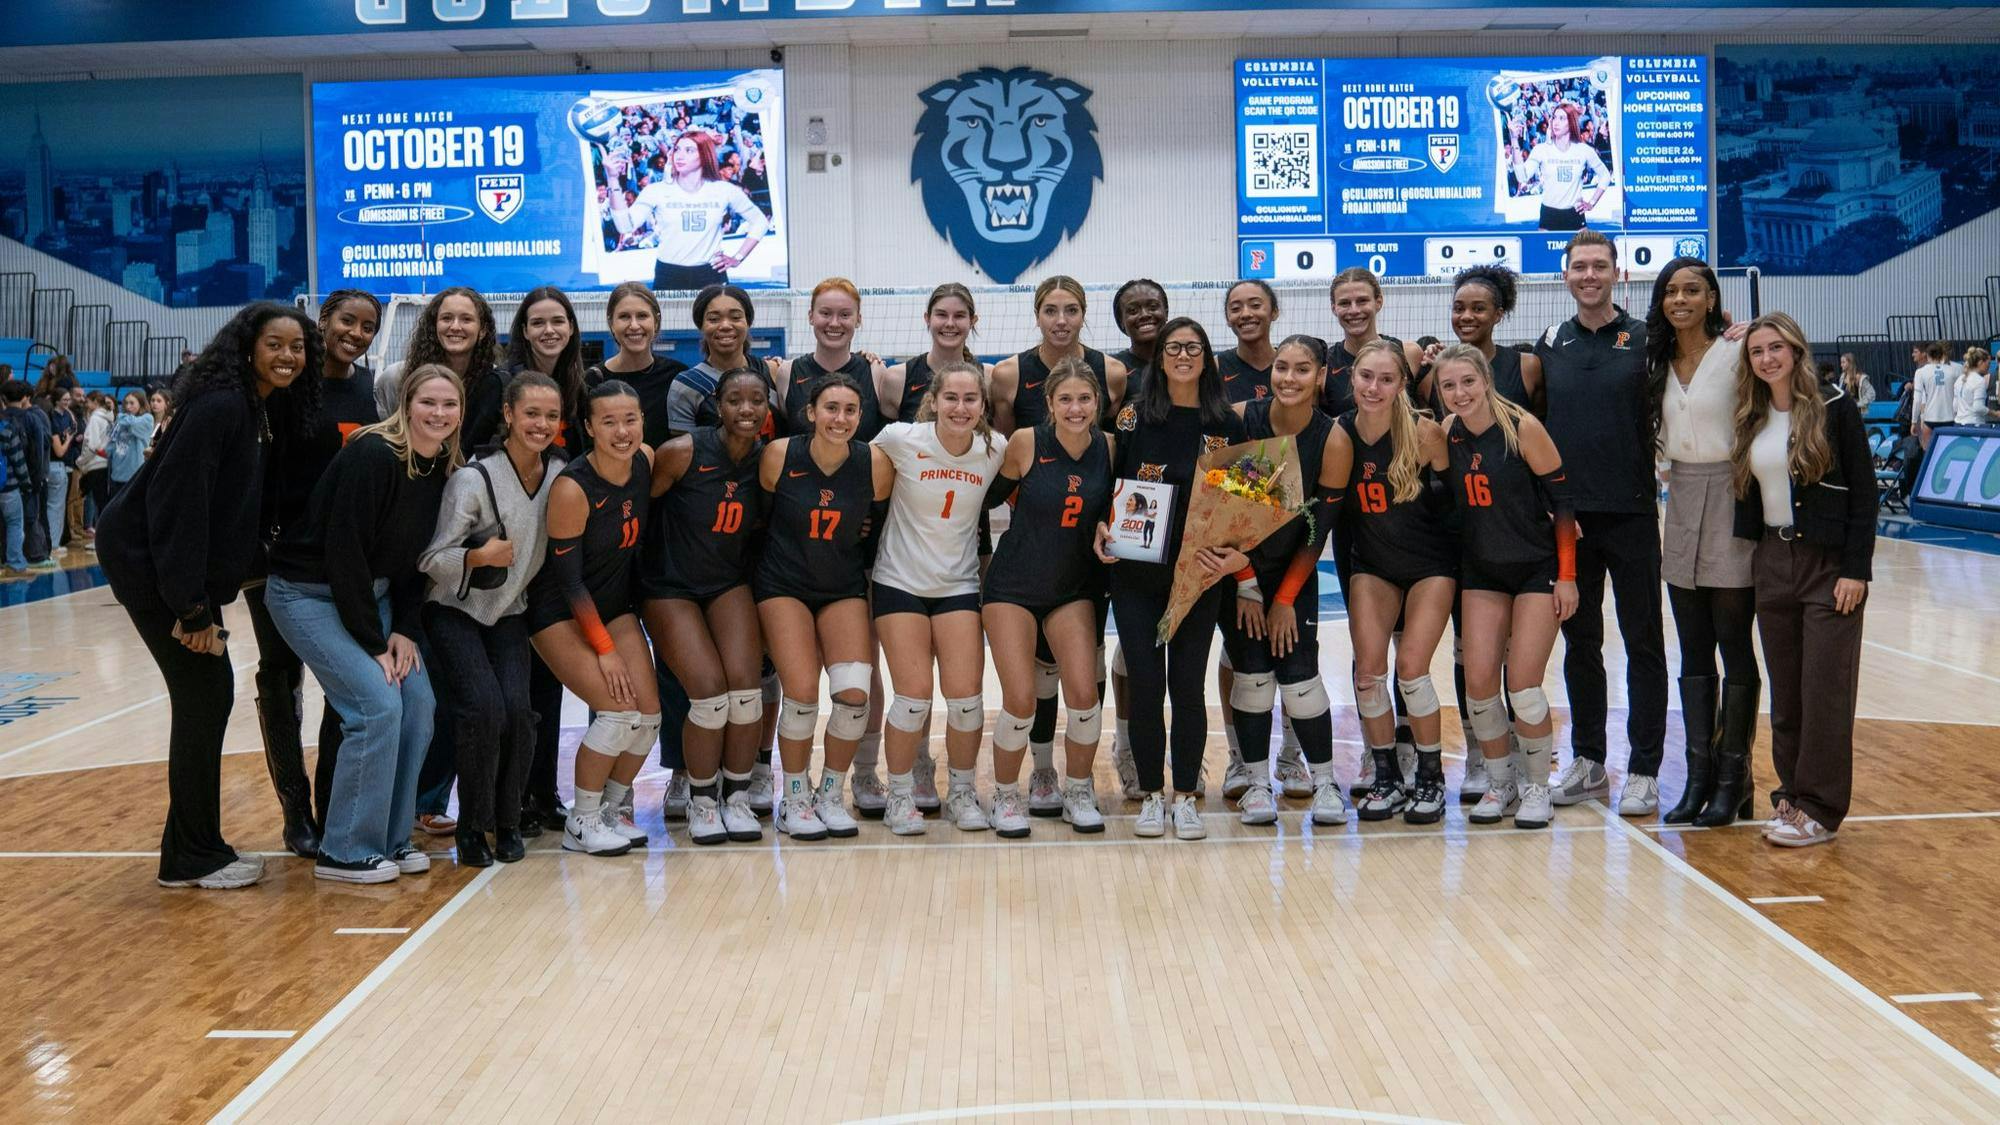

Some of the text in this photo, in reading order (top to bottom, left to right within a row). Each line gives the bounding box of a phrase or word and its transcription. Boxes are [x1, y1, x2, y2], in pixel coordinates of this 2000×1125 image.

[1244, 61, 1315, 72] COLUMBIA
[1628, 59, 1697, 69] COLUMBIA
[1241, 77, 1319, 87] VOLLEYBALL
[1626, 74, 1701, 83] VOLLEYBALL
[1342, 83, 1414, 93] NEXT HOME MATCH
[1248, 95, 1313, 105] GAME PROGRAM
[1636, 91, 1691, 101] UPCOMING
[1244, 105, 1319, 117] SCAN THE QR CODE
[1343, 95, 1459, 129] OCTOBER 19
[1623, 103, 1704, 113] HOME MATCHES
[342, 111, 453, 125] NEXT HOME MATCH
[1636, 121, 1693, 130] OCTOBER 19
[343, 125, 524, 171] OCTOBER 19
[1388, 138, 1401, 152] PM
[1431, 137, 1456, 145] PENN
[1636, 146, 1694, 155] OCTOBER 26
[1674, 156, 1690, 164] 6:00
[1557, 166, 1573, 182] 15
[1636, 175, 1695, 184] NOVEMBER 1
[481, 178, 520, 188] PENN
[413, 182, 432, 199] PM
[358, 207, 445, 223] ADMISSION IS FREE!
[681, 210, 707, 232] 15
[342, 243, 423, 262] @CULIONSVB
[433, 240, 561, 260] @GOCOLUMBIALIONS
[1354, 242, 1399, 252] TIME OUTS
[1441, 245, 1454, 258] 0
[1493, 244, 1506, 258] 0
[1297, 251, 1314, 270] 0
[1635, 247, 1651, 265] 0
[342, 261, 444, 278] #ROARLIONROAR
[1368, 254, 1387, 277] 0
[1191, 281, 1214, 289] ROAR
[1398, 277, 1418, 285] LION
[1419, 276, 1441, 284] ROAR
[871, 288, 895, 296] ROAR
[1009, 285, 1033, 293] ROAR
[920, 469, 984, 486] PRINCETON
[1464, 473, 1492, 507] 16
[940, 489, 955, 519] 1
[1356, 482, 1387, 513] 19
[711, 501, 743, 534] 10
[1061, 495, 1084, 527] 2
[809, 508, 841, 540] 17
[1120, 519, 1145, 531] 200
[618, 516, 639, 549] 11
